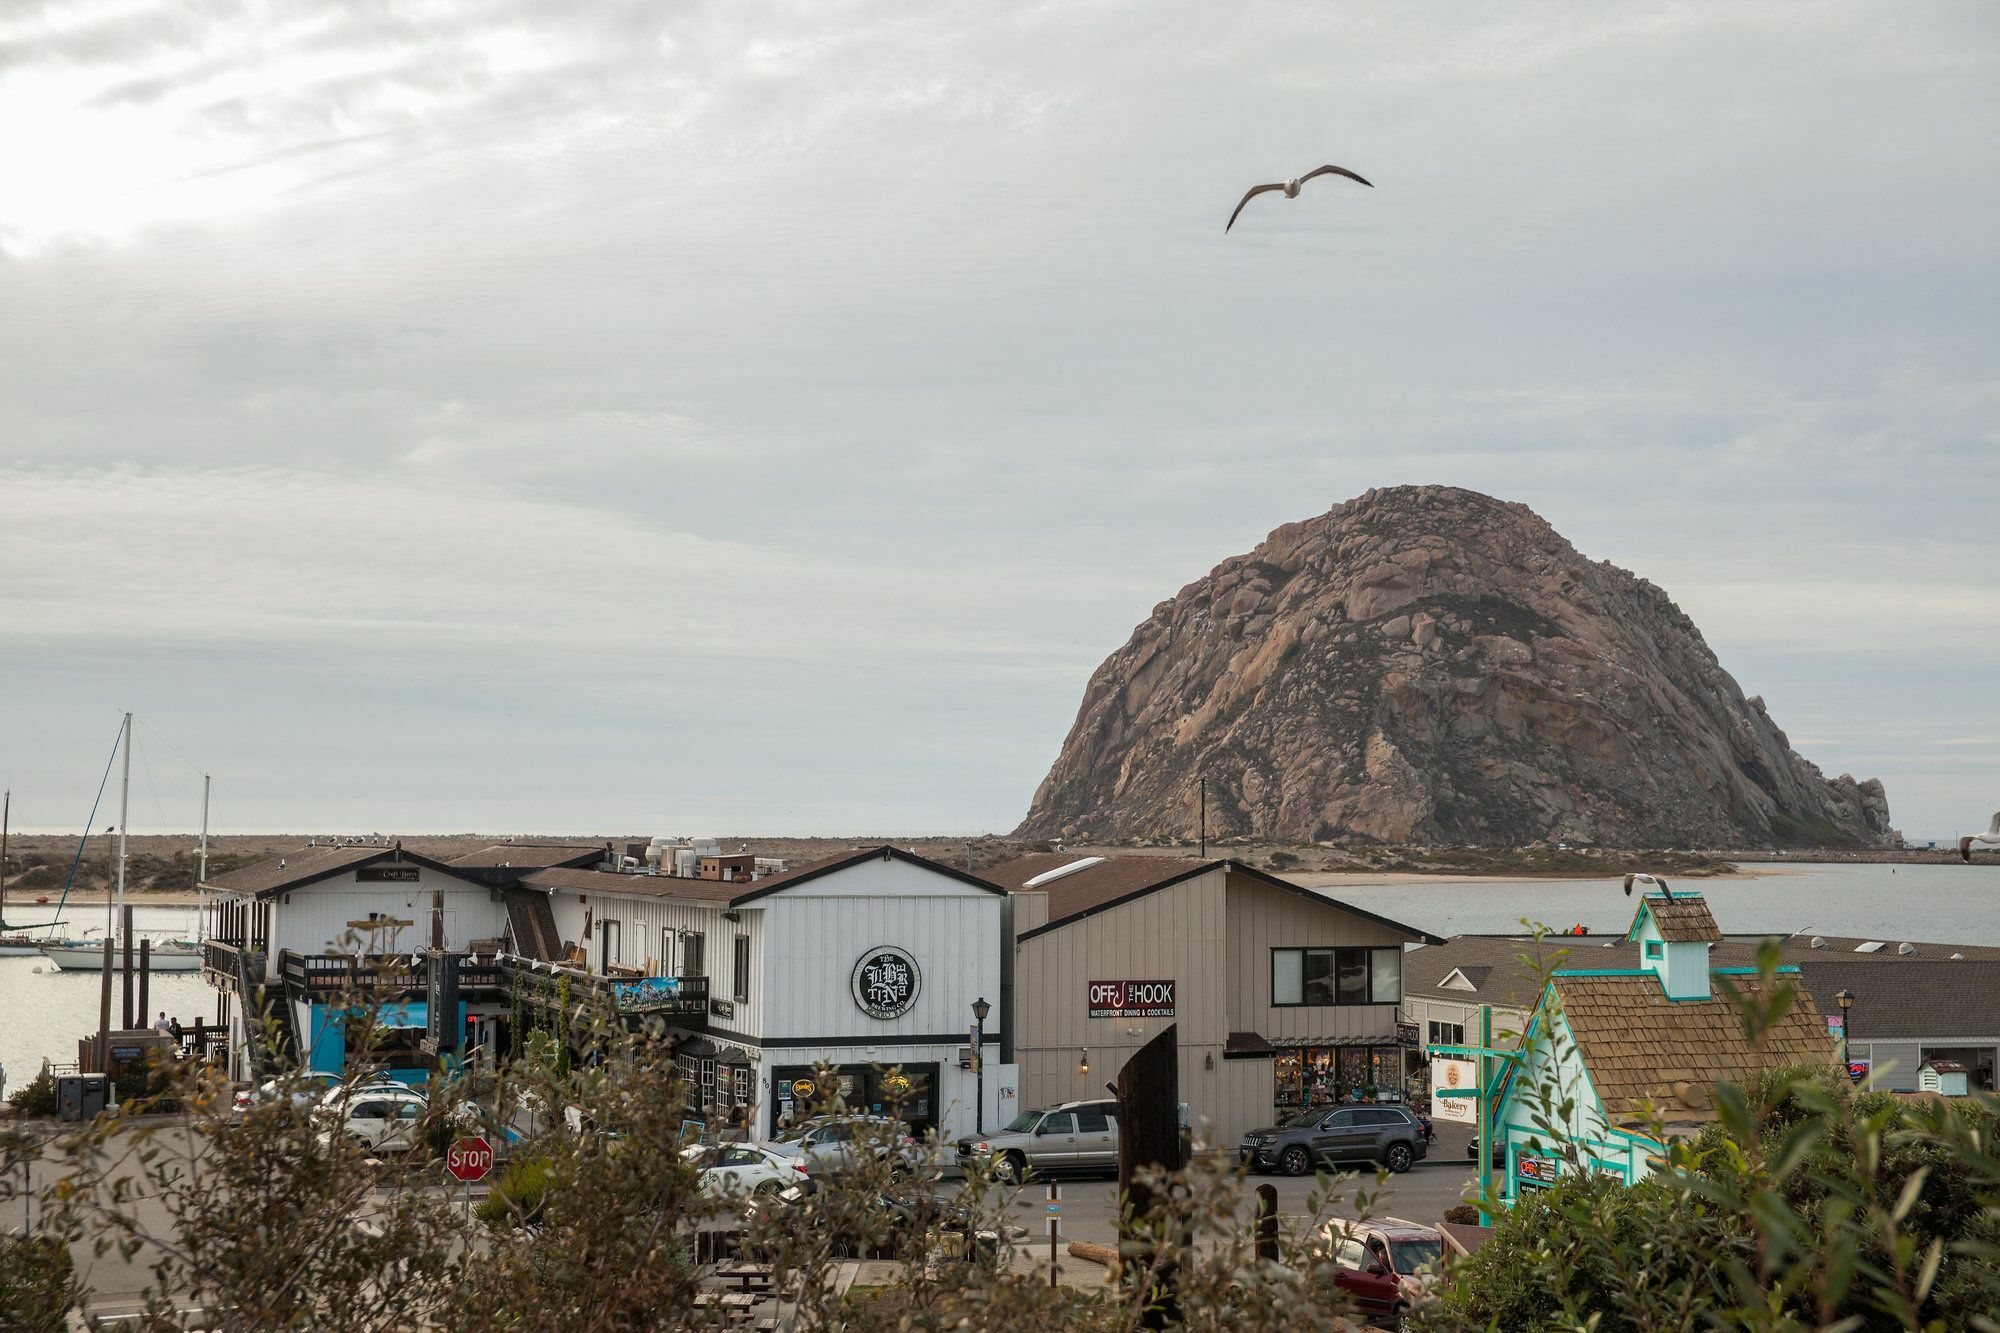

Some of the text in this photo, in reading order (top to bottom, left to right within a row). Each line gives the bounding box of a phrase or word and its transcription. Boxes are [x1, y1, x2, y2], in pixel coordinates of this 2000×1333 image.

[1090, 985, 1115, 1003] OFF
[1134, 984, 1172, 1003] HOOK
[865, 1006, 891, 1019] MORRO
[870, 1002, 897, 1012] BREWING
[1090, 1009, 1123, 1017] WATERFRONT
[1124, 1009, 1141, 1017] DINING
[1147, 1008, 1174, 1016] COCKTAILS
[1849, 1063, 1866, 1073] OPEN
[1443, 1099, 1468, 1112] Bakery
[450, 1151, 490, 1167] STOP
